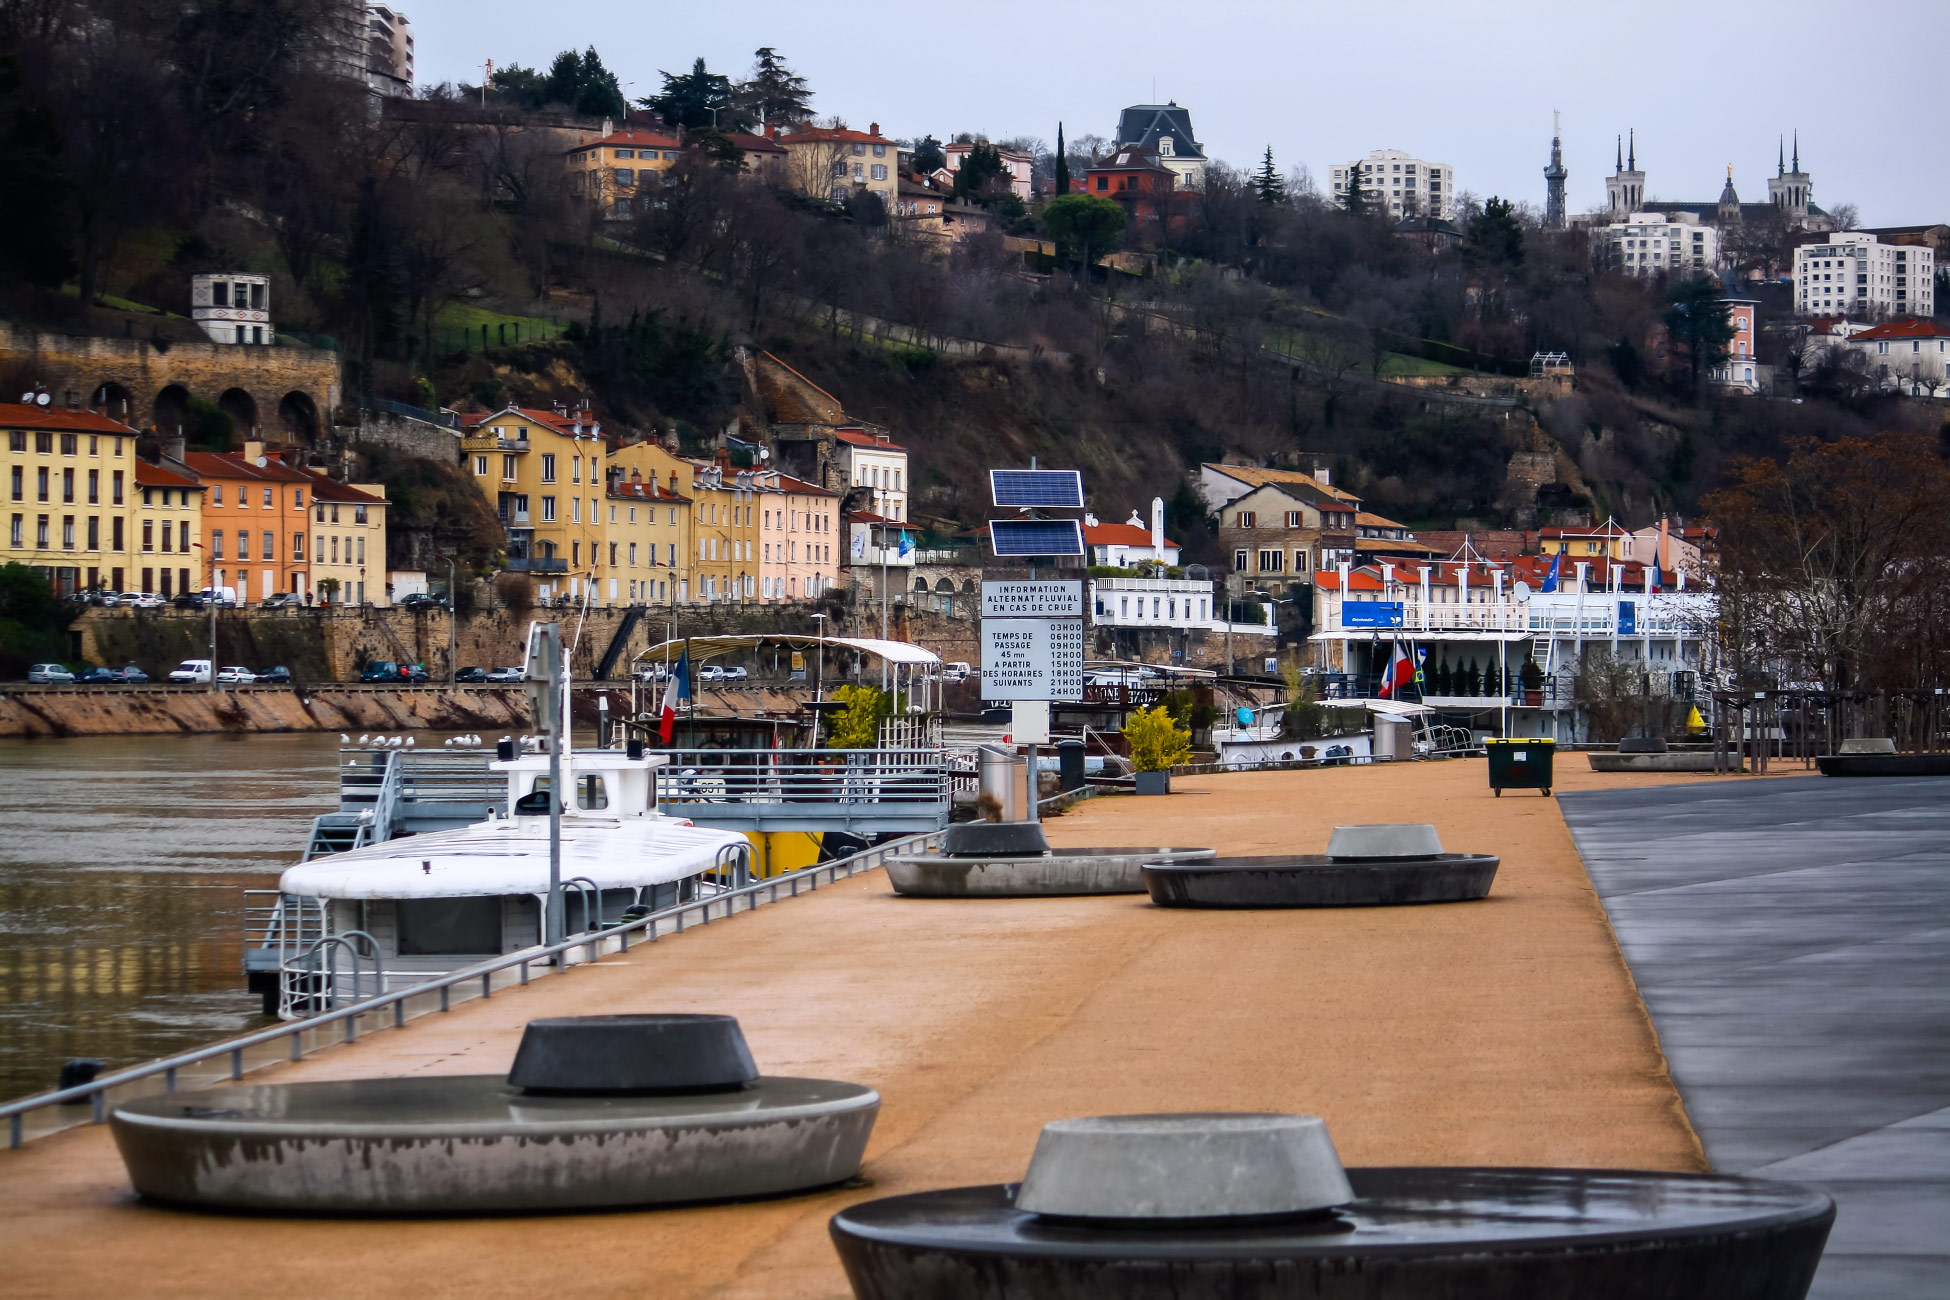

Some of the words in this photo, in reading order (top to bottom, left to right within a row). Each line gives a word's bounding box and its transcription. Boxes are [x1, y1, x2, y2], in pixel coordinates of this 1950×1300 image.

[999, 585, 1066, 594] INFORMATION
[987, 594, 1035, 603] ALTERNAT
[1039, 594, 1079, 602] FLUVIAL
[993, 603, 1005, 612] EN
[1009, 603, 1027, 612] CAS
[1031, 603, 1044, 612] DE
[1047, 602, 1073, 611] CRUE
[1050, 623, 1082, 632] 03H00
[992, 632, 1020, 640] TEMPS
[1022, 632, 1033, 640] DE
[1050, 632, 1082, 641] 06H00
[994, 641, 1031, 649] PASSAGE
[1050, 642, 1082, 650] 09H00
[1000, 650, 1011, 658] 45
[1050, 651, 1082, 659] 12H00
[994, 660, 1000, 669] A
[1002, 660, 1031, 669] PARTIR
[1050, 660, 1082, 668] 15H00
[982, 670, 999, 678] DES
[1001, 670, 1043, 678] HORAIRES
[1050, 669, 1082, 677] 18H00
[993, 679, 1033, 687] SUIVANTS
[1050, 678, 1082, 686] 21H00
[1050, 687, 1082, 696] 24H00
